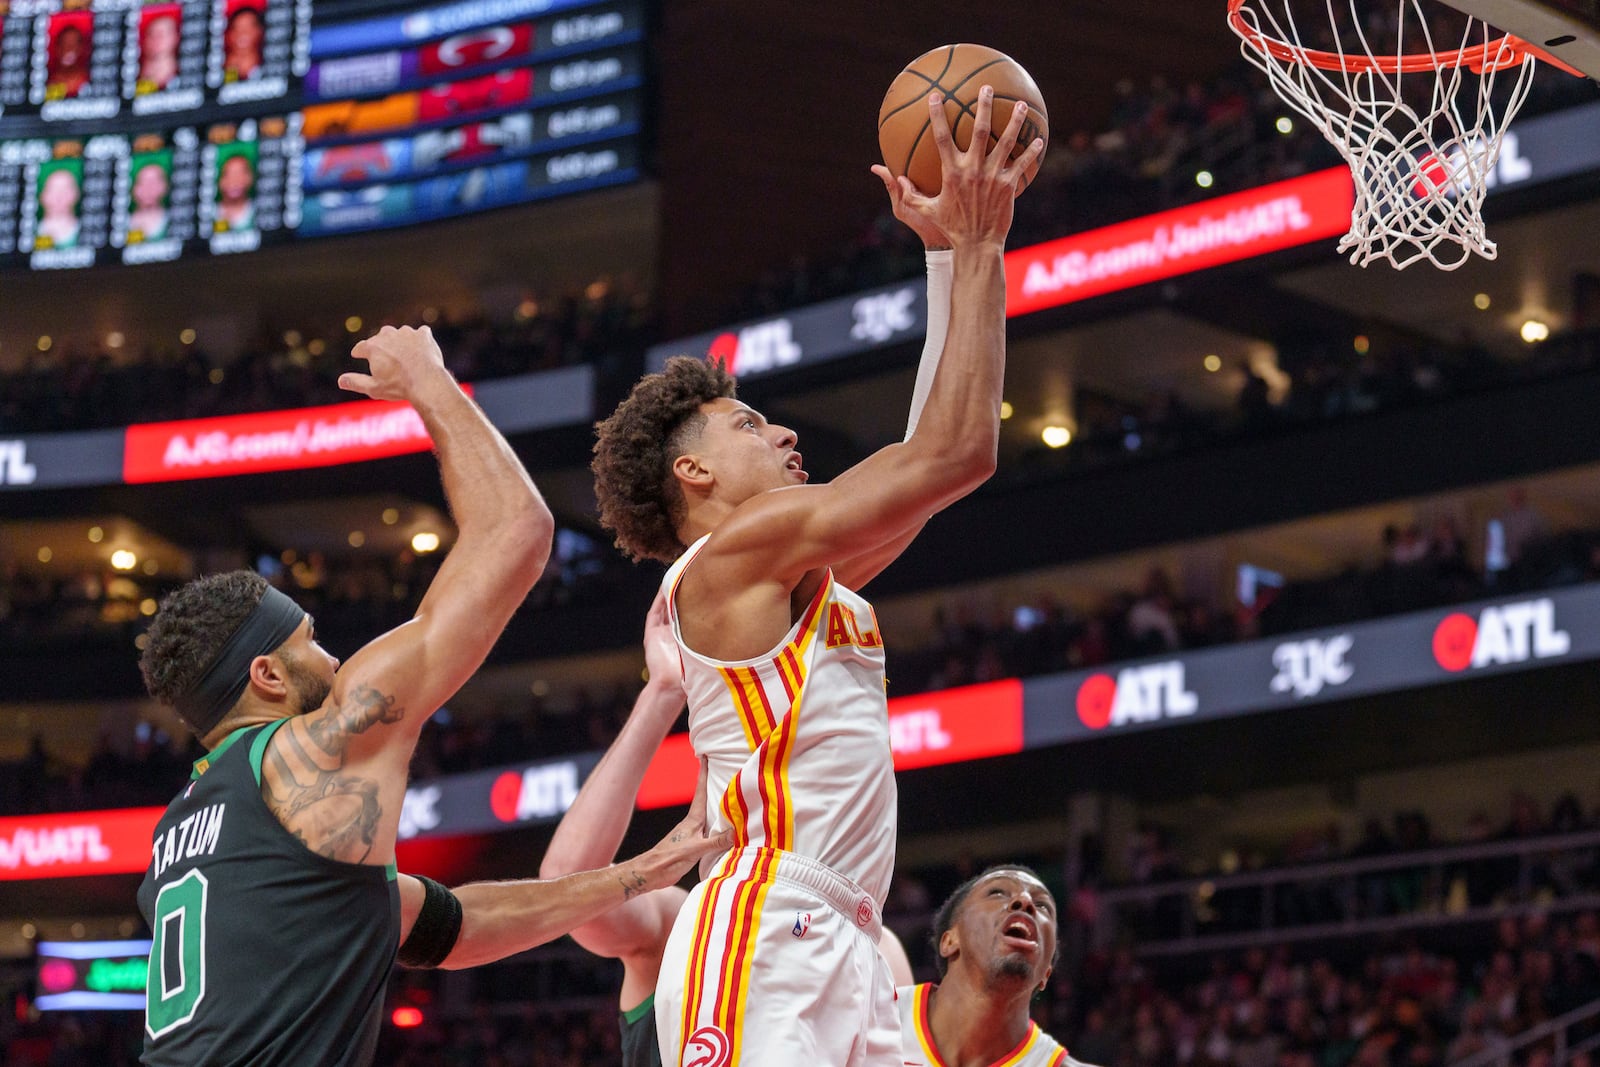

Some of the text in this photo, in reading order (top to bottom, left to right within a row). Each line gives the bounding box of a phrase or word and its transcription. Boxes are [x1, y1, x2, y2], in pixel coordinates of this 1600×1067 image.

[735, 318, 802, 375] ATL
[1473, 599, 1570, 668] ATL
[1110, 660, 1198, 726] ATL
[152, 803, 226, 881] TATUM
[145, 867, 208, 1040] 0
